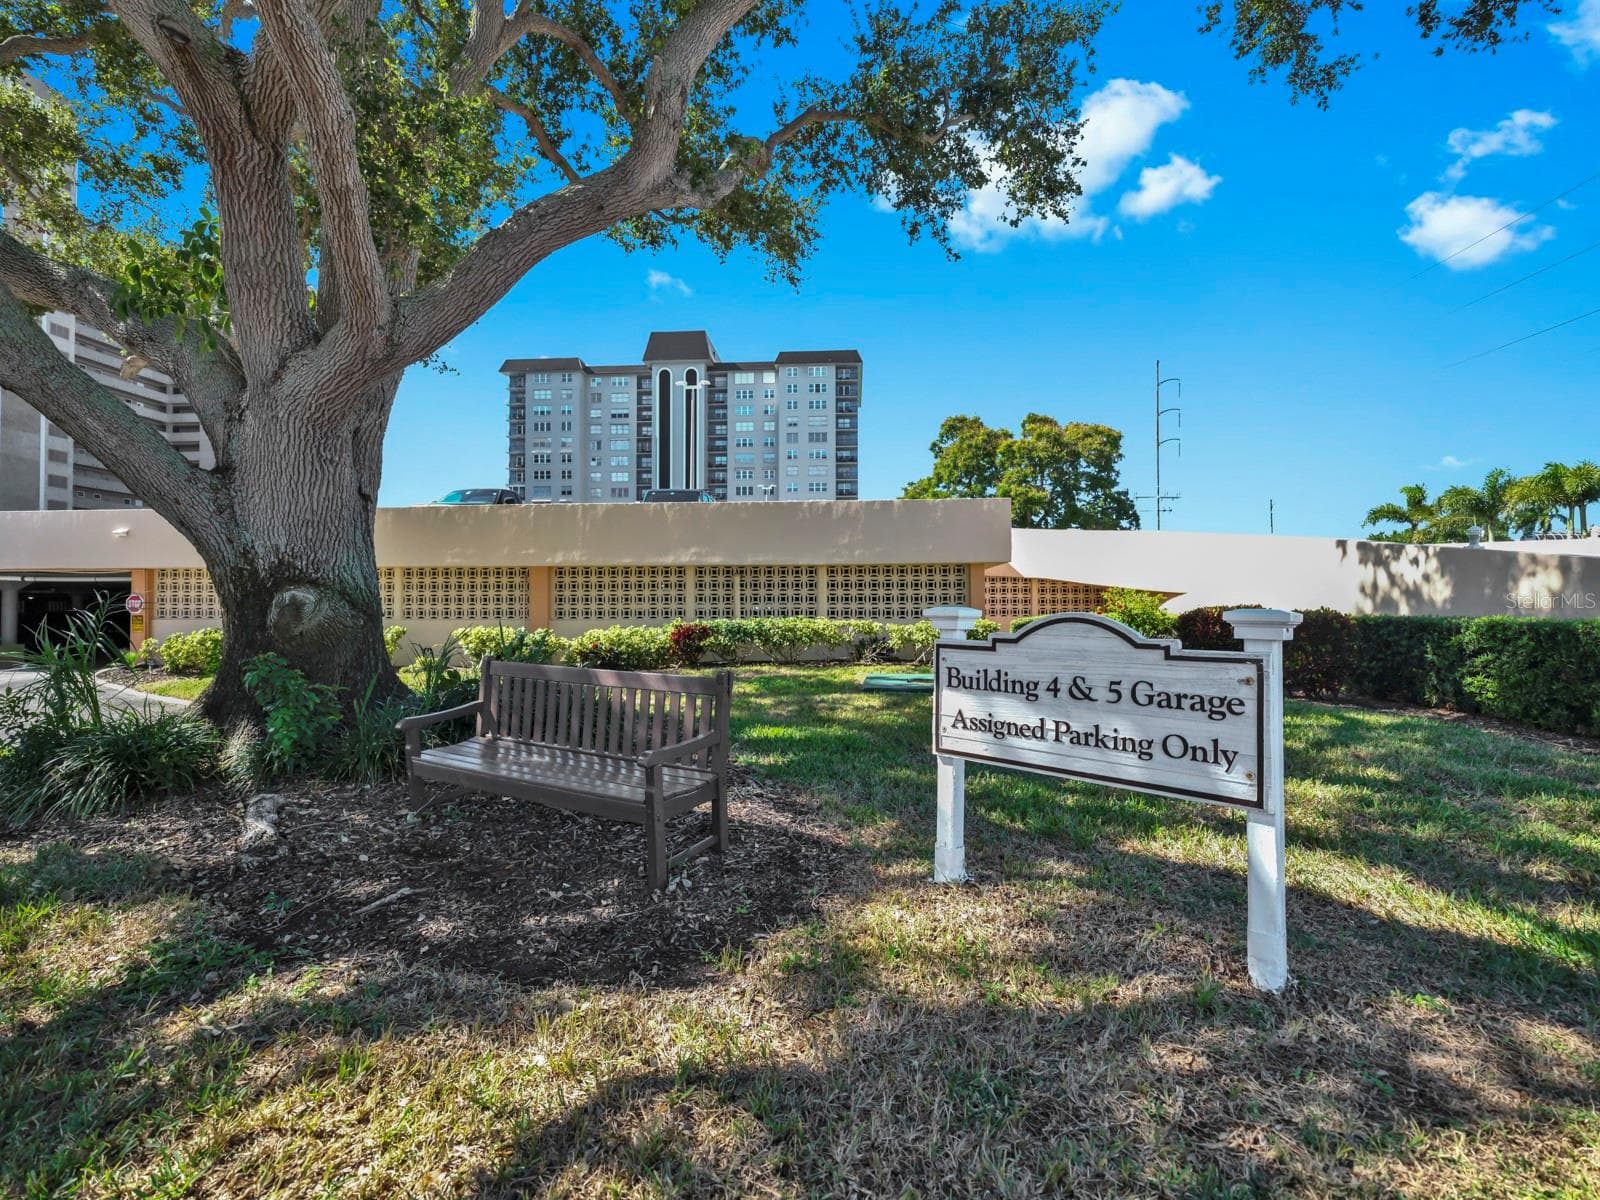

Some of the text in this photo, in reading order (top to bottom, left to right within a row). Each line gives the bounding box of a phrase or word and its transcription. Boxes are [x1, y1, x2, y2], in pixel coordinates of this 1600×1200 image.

[945, 666, 1246, 721] Building 4 & 5 Garage
[951, 708, 1239, 774] Assigned Parking Only
